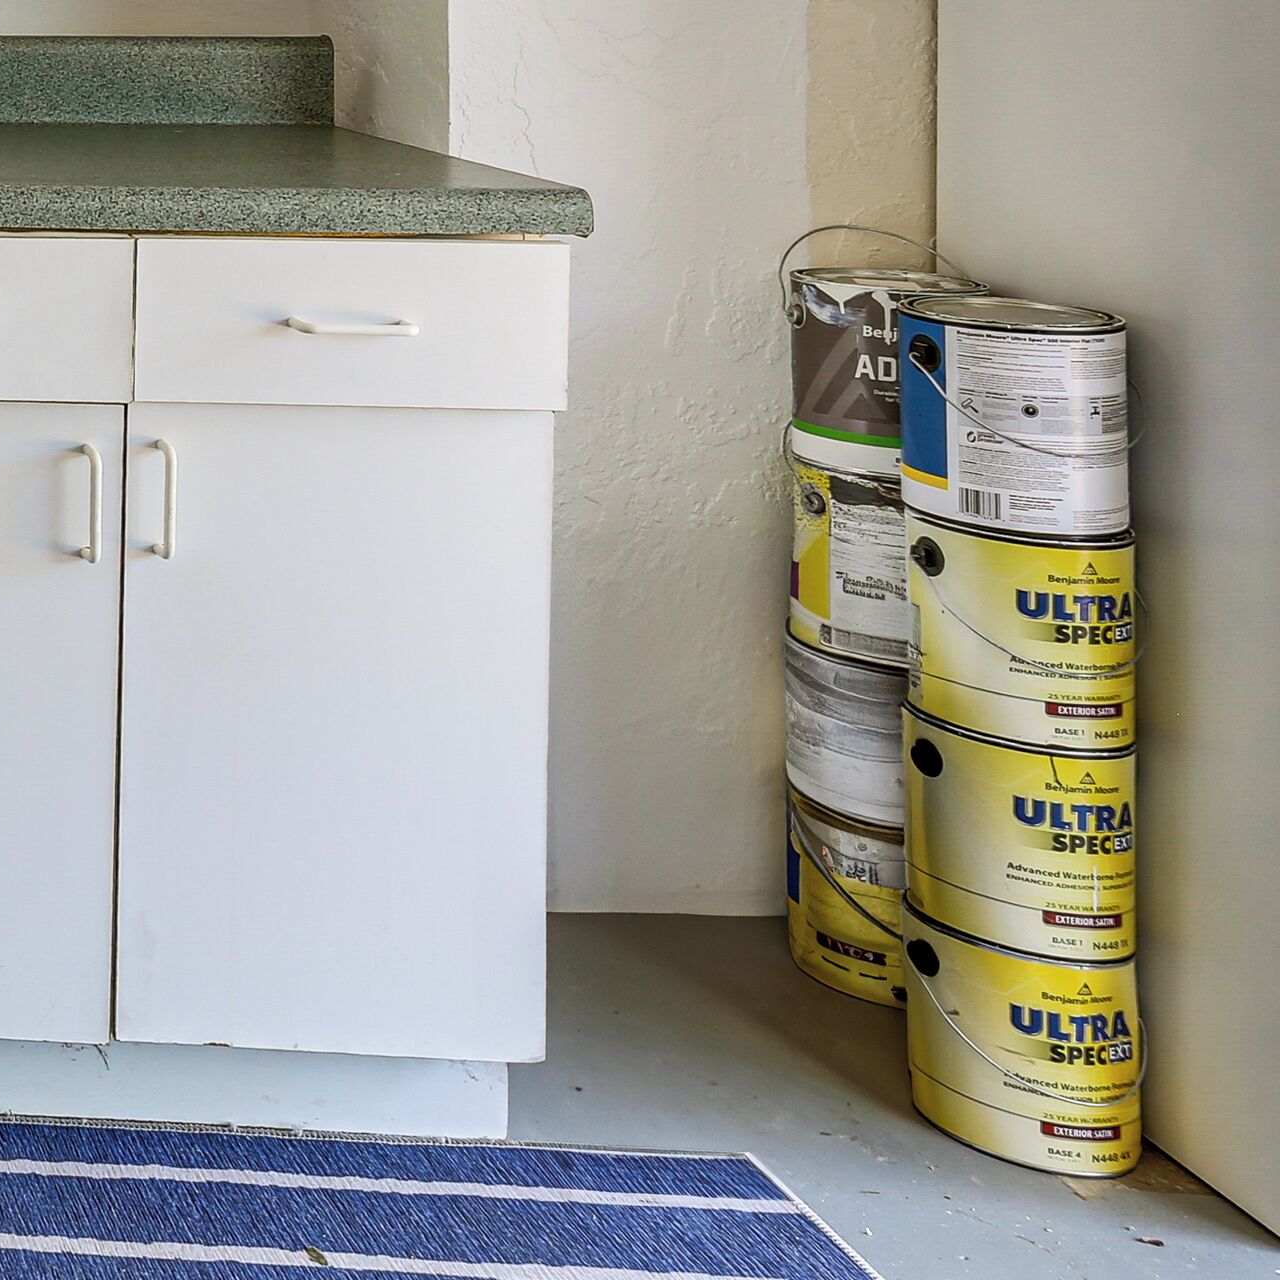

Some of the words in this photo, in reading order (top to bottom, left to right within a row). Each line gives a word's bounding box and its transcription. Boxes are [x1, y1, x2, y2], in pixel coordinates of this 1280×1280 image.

[854, 354, 897, 382] AD
[1048, 574, 1095, 585] Benjamin
[1015, 588, 1133, 623] ULTRA
[1054, 623, 1113, 645] SPEC
[1009, 666, 1057, 679] ENHANCED
[1057, 705, 1096, 715] EXTERIOR
[1054, 727, 1079, 736] BASE
[1045, 782, 1092, 794] Benjamin
[1012, 794, 1133, 833] ULTRA
[1051, 833, 1112, 855] SPEC
[1007, 862, 1061, 878] Advanced
[1006, 873, 1054, 887] ENHANCED
[1059, 903, 1081, 911] YEAR
[1055, 915, 1094, 926] EXTERIOR
[1051, 936, 1077, 946] BASE
[1041, 991, 1089, 1005] Benjamin
[1009, 1002, 1132, 1043] ULTRA
[1049, 1044, 1108, 1066] SPEC
[1109, 1043, 1131, 1060] EXT
[1060, 1083, 1112, 1093] Waterborne
[1056, 1114, 1077, 1122] YEAR
[1054, 1126, 1093, 1138] EXTERIOR
[1093, 1129, 1114, 1138] SATIN
[1048, 1148, 1073, 1158] BASE
